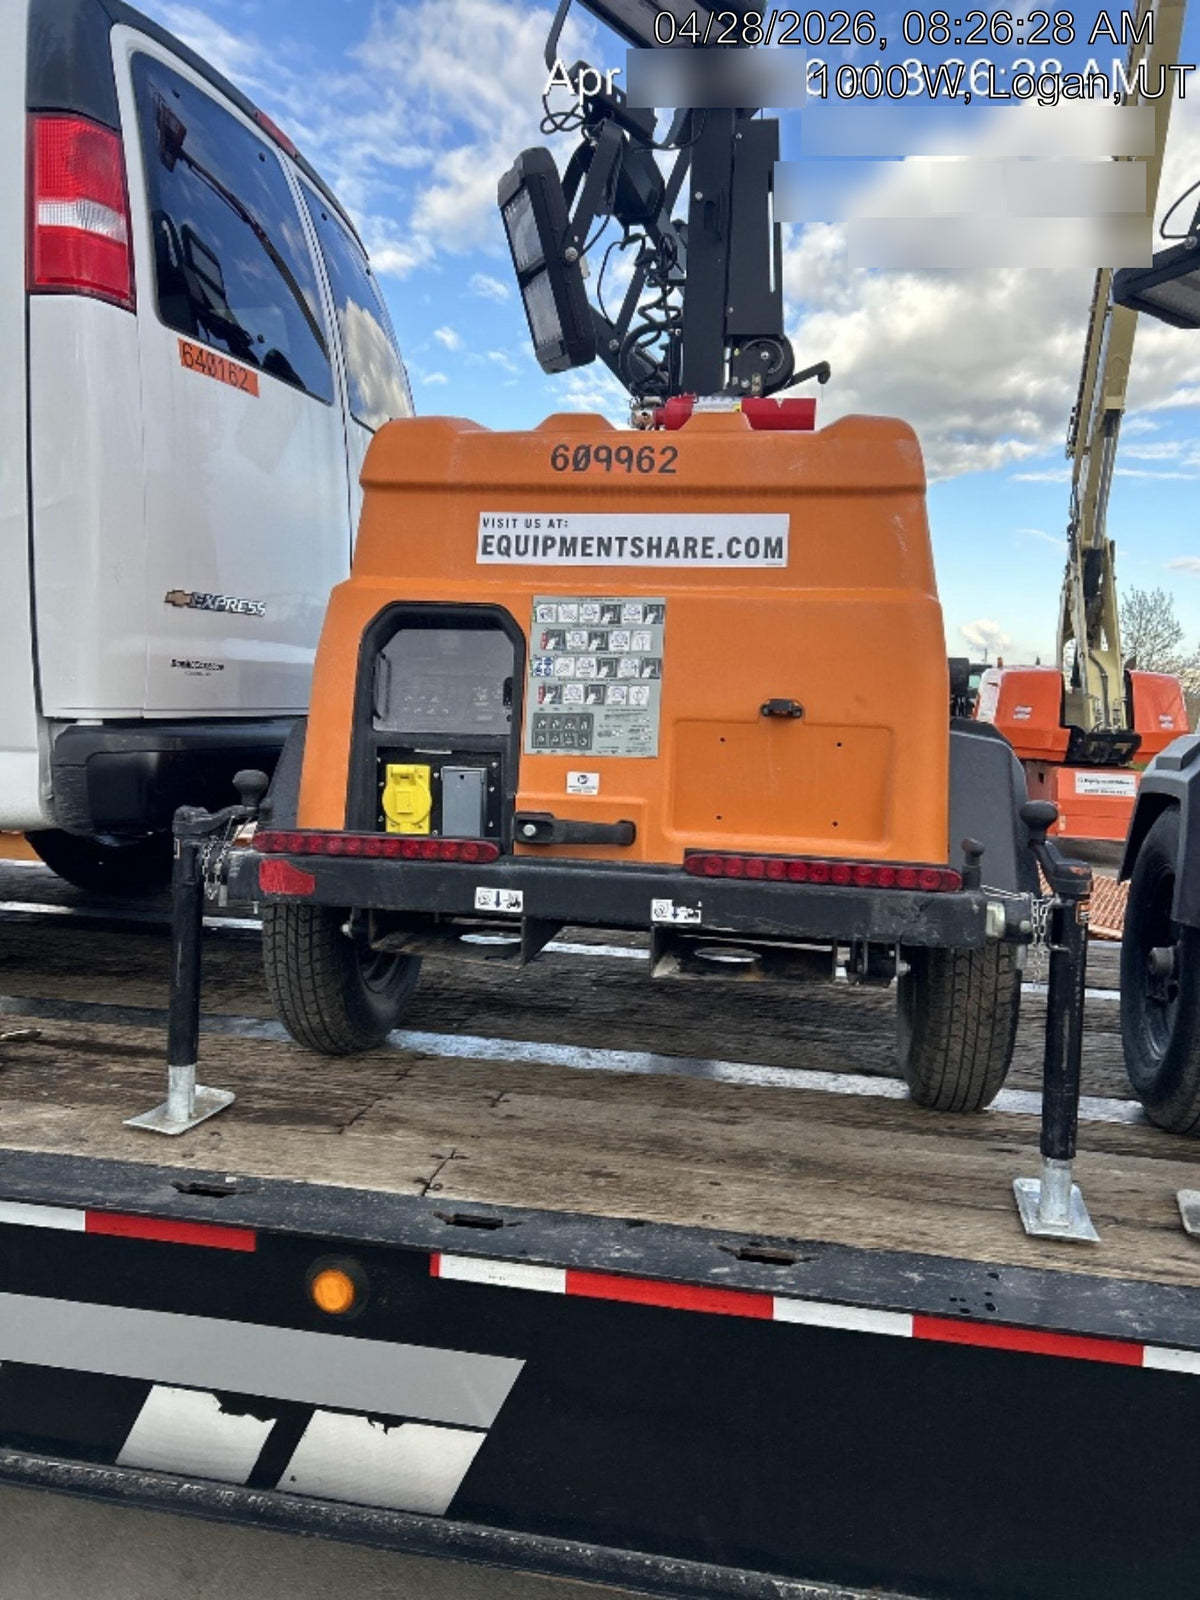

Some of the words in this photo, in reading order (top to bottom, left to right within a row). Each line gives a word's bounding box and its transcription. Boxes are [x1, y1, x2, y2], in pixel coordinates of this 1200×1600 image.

[182, 342, 249, 392] 640162
[550, 443, 679, 474] 609962
[482, 517, 518, 529] VISIT
[525, 518, 541, 529] US
[547, 518, 569, 529] AT:
[480, 534, 784, 560] EQUIPMENTSHARE.COM
[190, 592, 267, 617] EXPRESS
